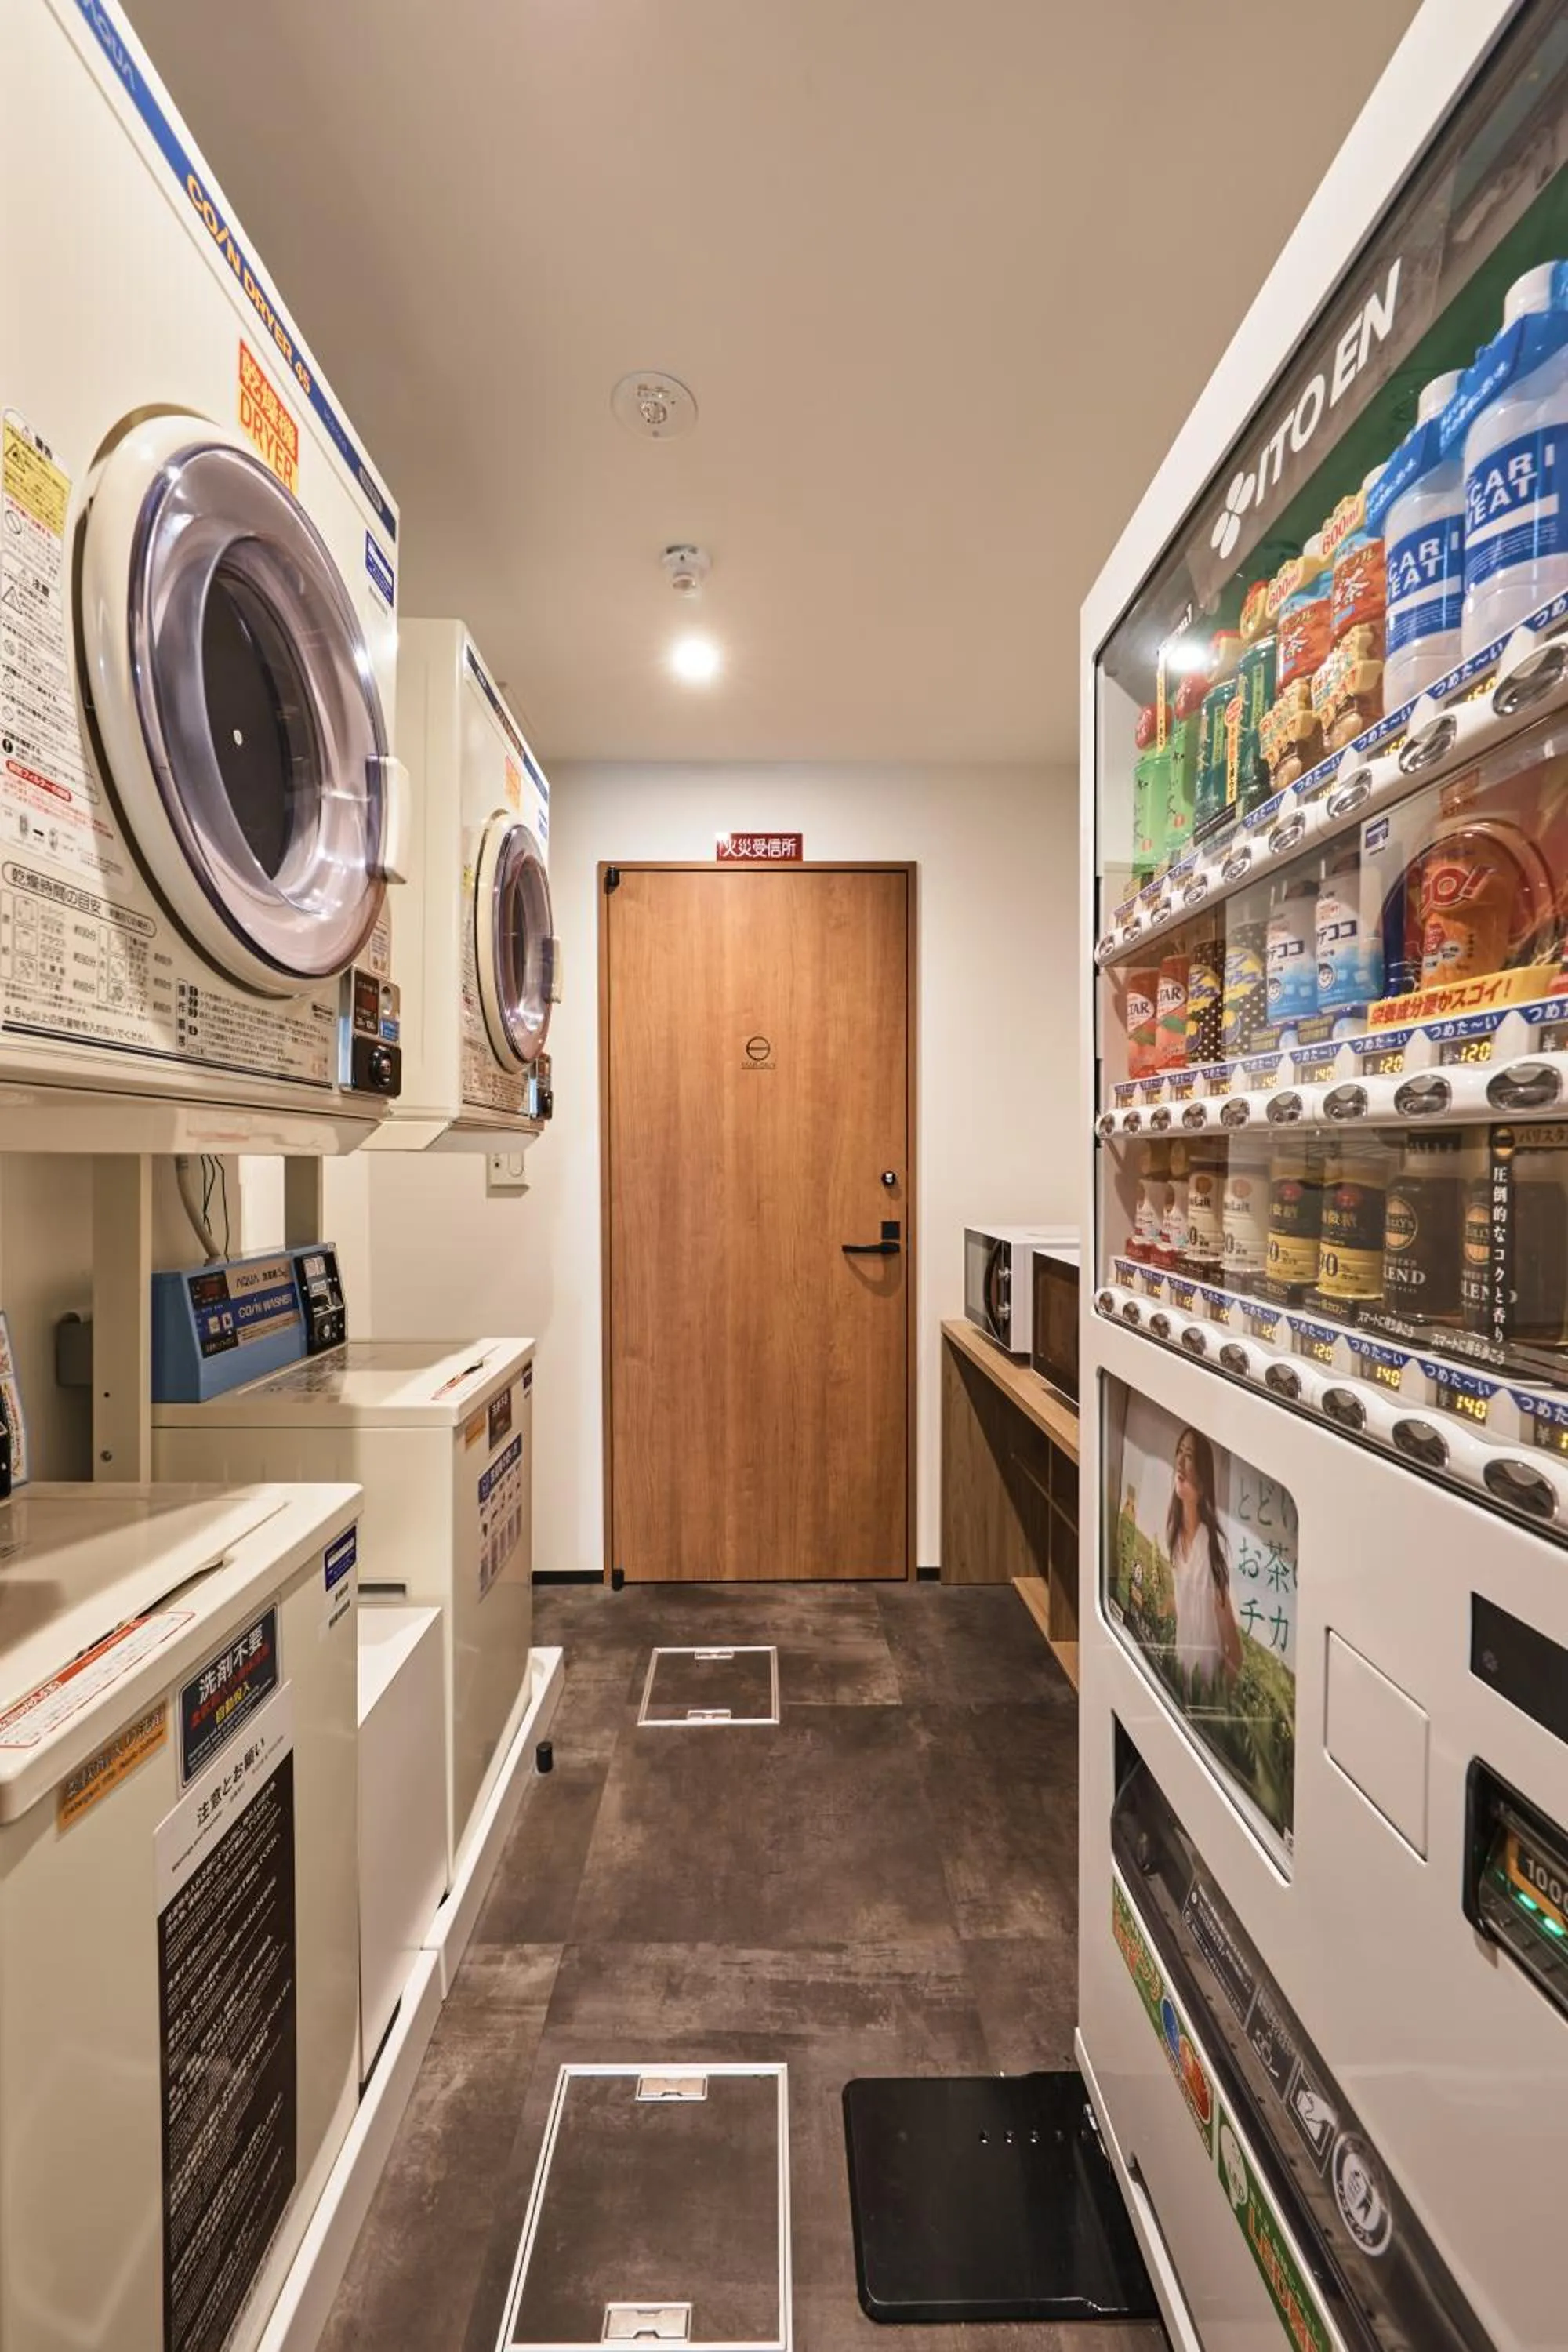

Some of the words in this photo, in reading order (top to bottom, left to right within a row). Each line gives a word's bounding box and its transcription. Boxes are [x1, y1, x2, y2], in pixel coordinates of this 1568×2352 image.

[243, 267, 293, 363] DRYER
[240, 351, 299, 456] 乾燥機
[1256, 374, 1326, 506] ITO
[1330, 256, 1402, 408] EN
[240, 389, 294, 492] DRYER
[722, 838, 797, 858] 火災受信所
[1379, 1054, 1404, 1073] 120
[1461, 1041, 1491, 1062] 120
[1492, 1166, 1508, 1343] 圧倒的なコクと香り
[263, 1293, 293, 1312] WASHER
[1314, 1343, 1333, 1360] 120
[1377, 1365, 1401, 1387] 140
[1457, 1395, 1487, 1419] 140
[199, 1624, 263, 1704] 洗剤不要
[197, 1737, 265, 1828] 注意とお願い
